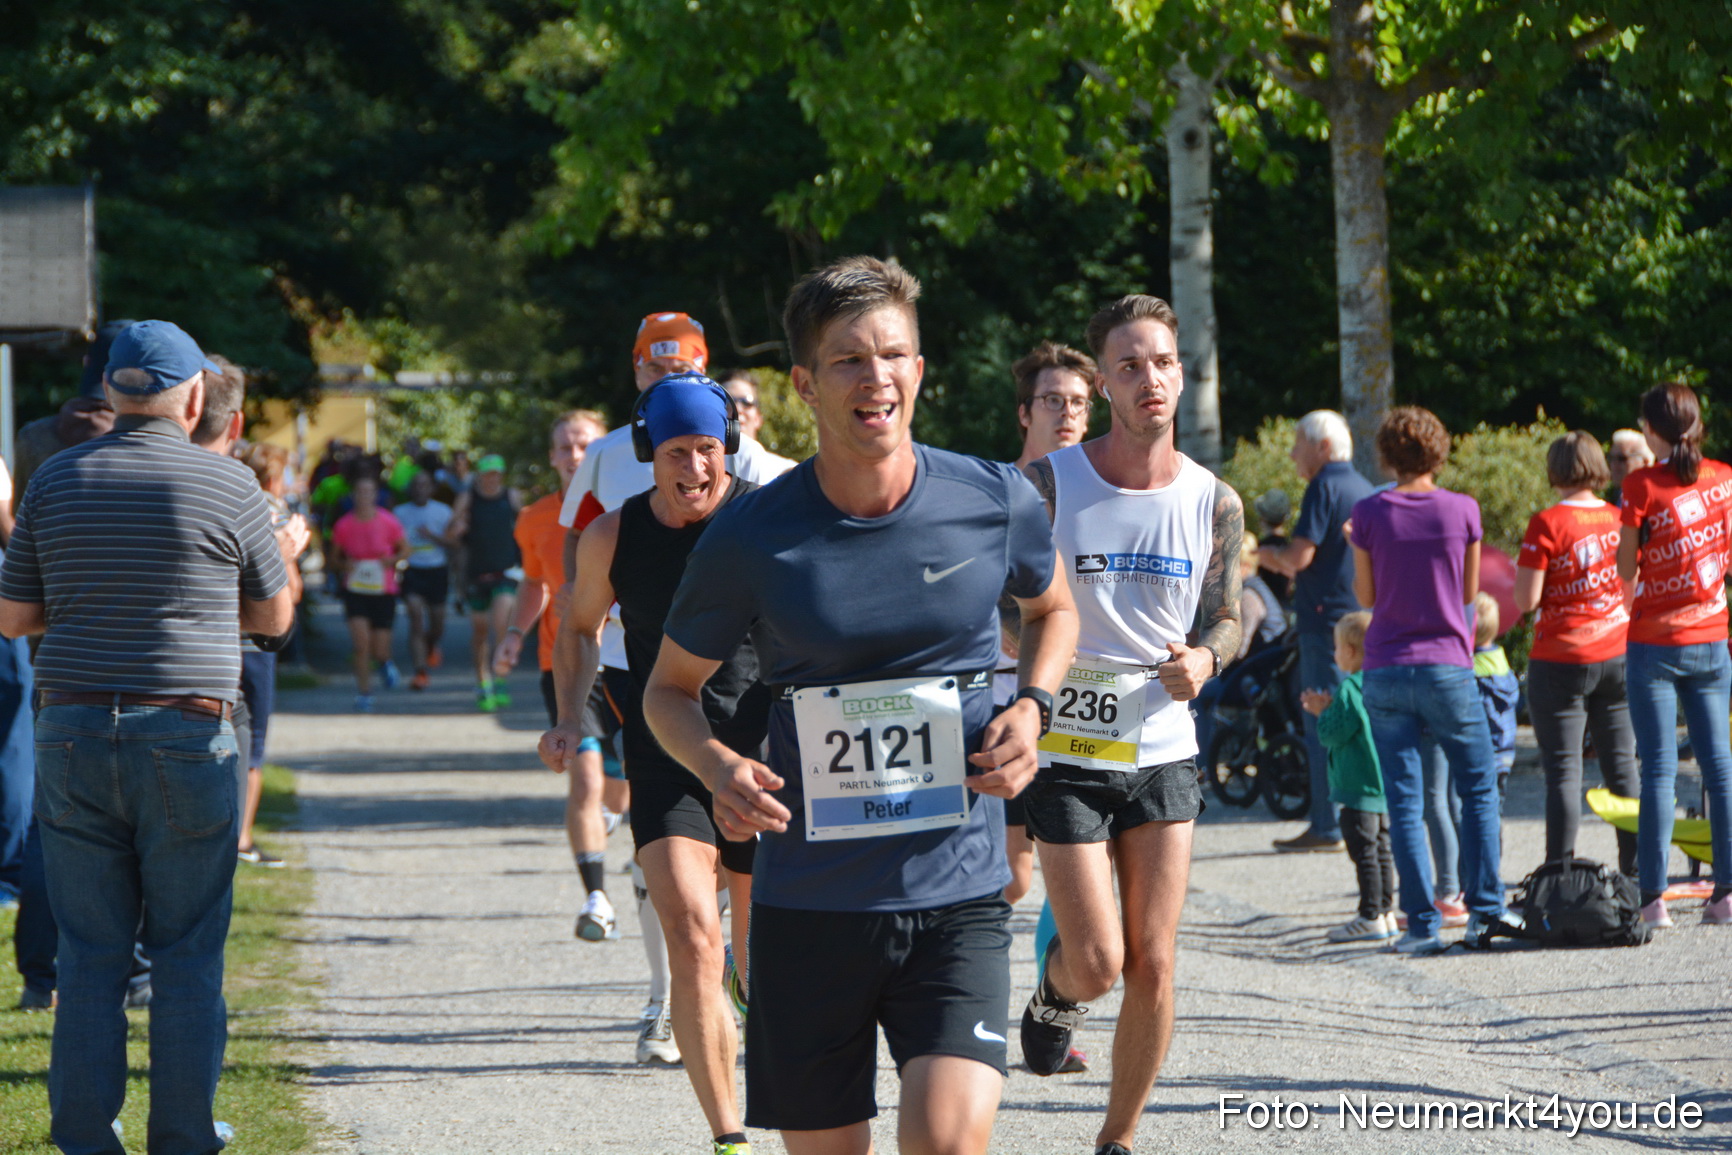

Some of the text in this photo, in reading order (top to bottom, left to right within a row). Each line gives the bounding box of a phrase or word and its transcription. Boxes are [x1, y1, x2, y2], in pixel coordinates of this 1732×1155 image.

[1068, 668, 1116, 684] BOCK
[843, 694, 914, 715] BOCK
[1057, 687, 1118, 724] 236
[1053, 722, 1109, 736] PARTL Neumarkt
[825, 722, 932, 774] 2121
[1070, 739, 1095, 755] Eric
[839, 775, 919, 790] PARTL Neumarkt
[864, 799, 912, 819] Peter
